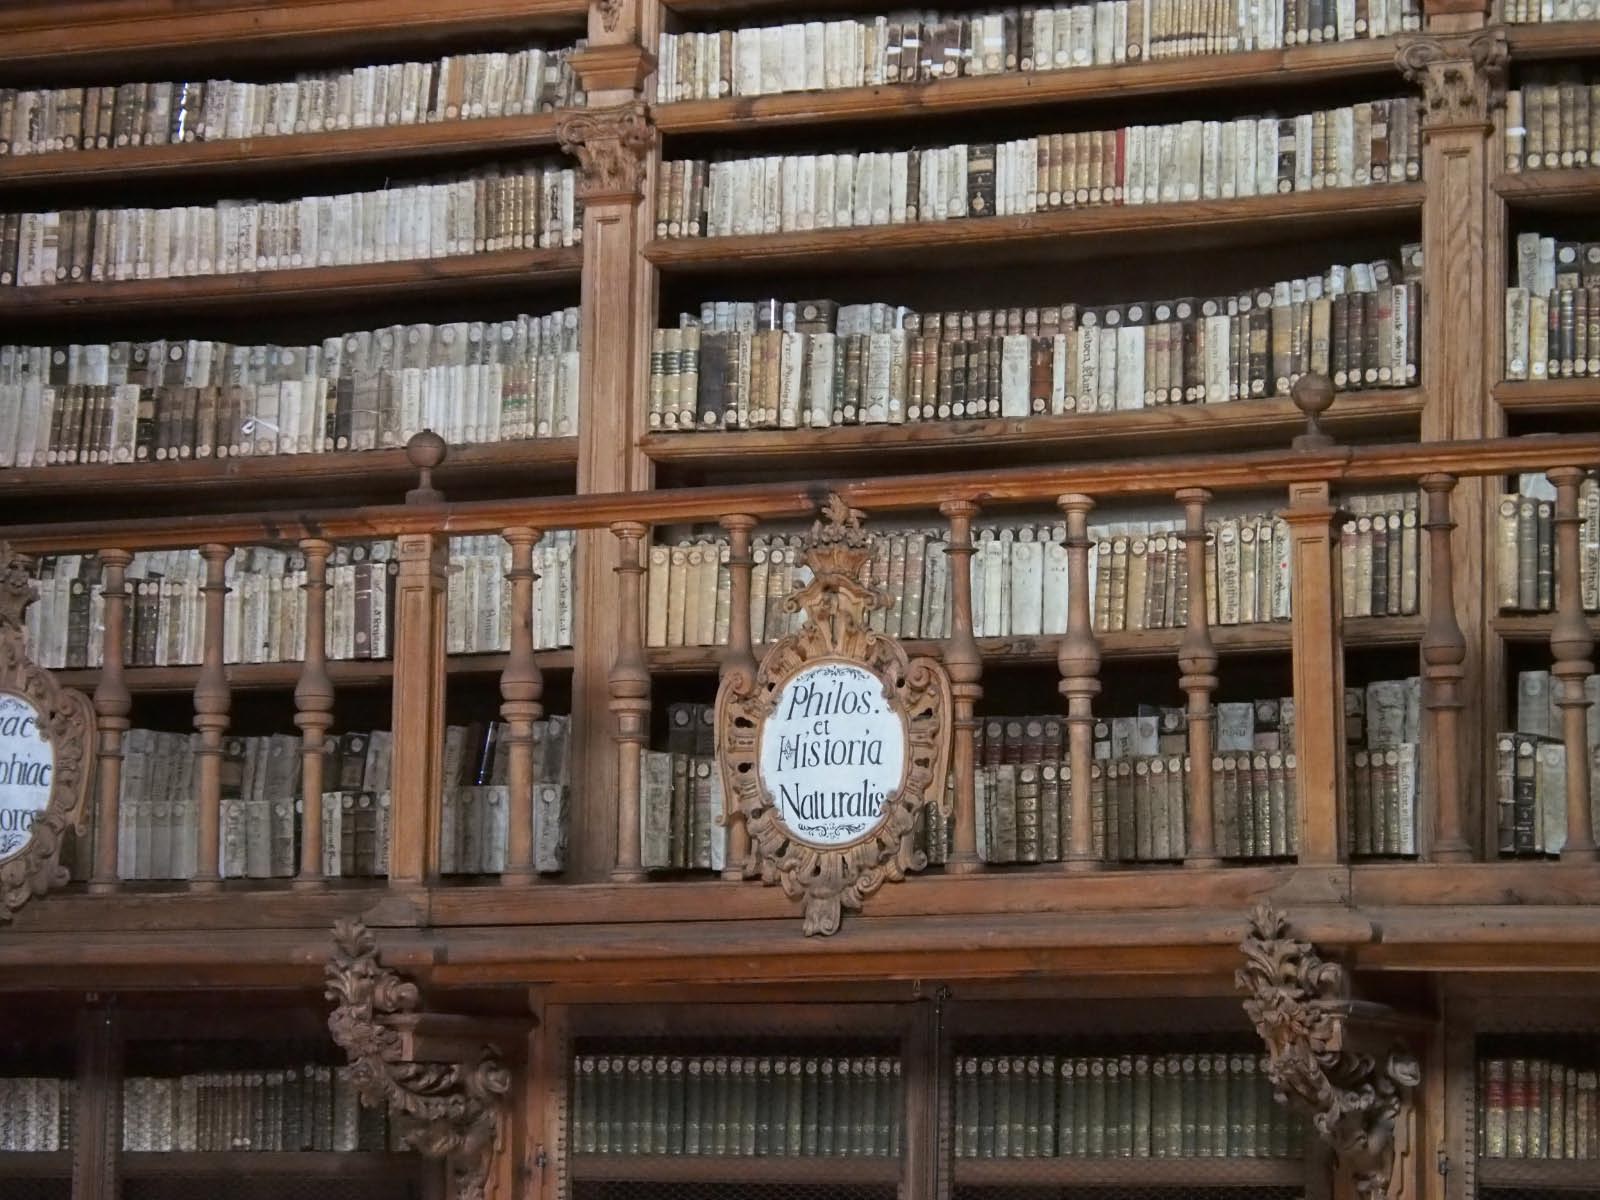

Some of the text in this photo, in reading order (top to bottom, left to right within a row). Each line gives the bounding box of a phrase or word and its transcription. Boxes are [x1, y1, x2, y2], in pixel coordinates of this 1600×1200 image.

[787, 680, 880, 720] Philos.
[813, 719, 831, 735] et
[776, 728, 884, 772] Historia
[779, 778, 885, 822] Naturalis
